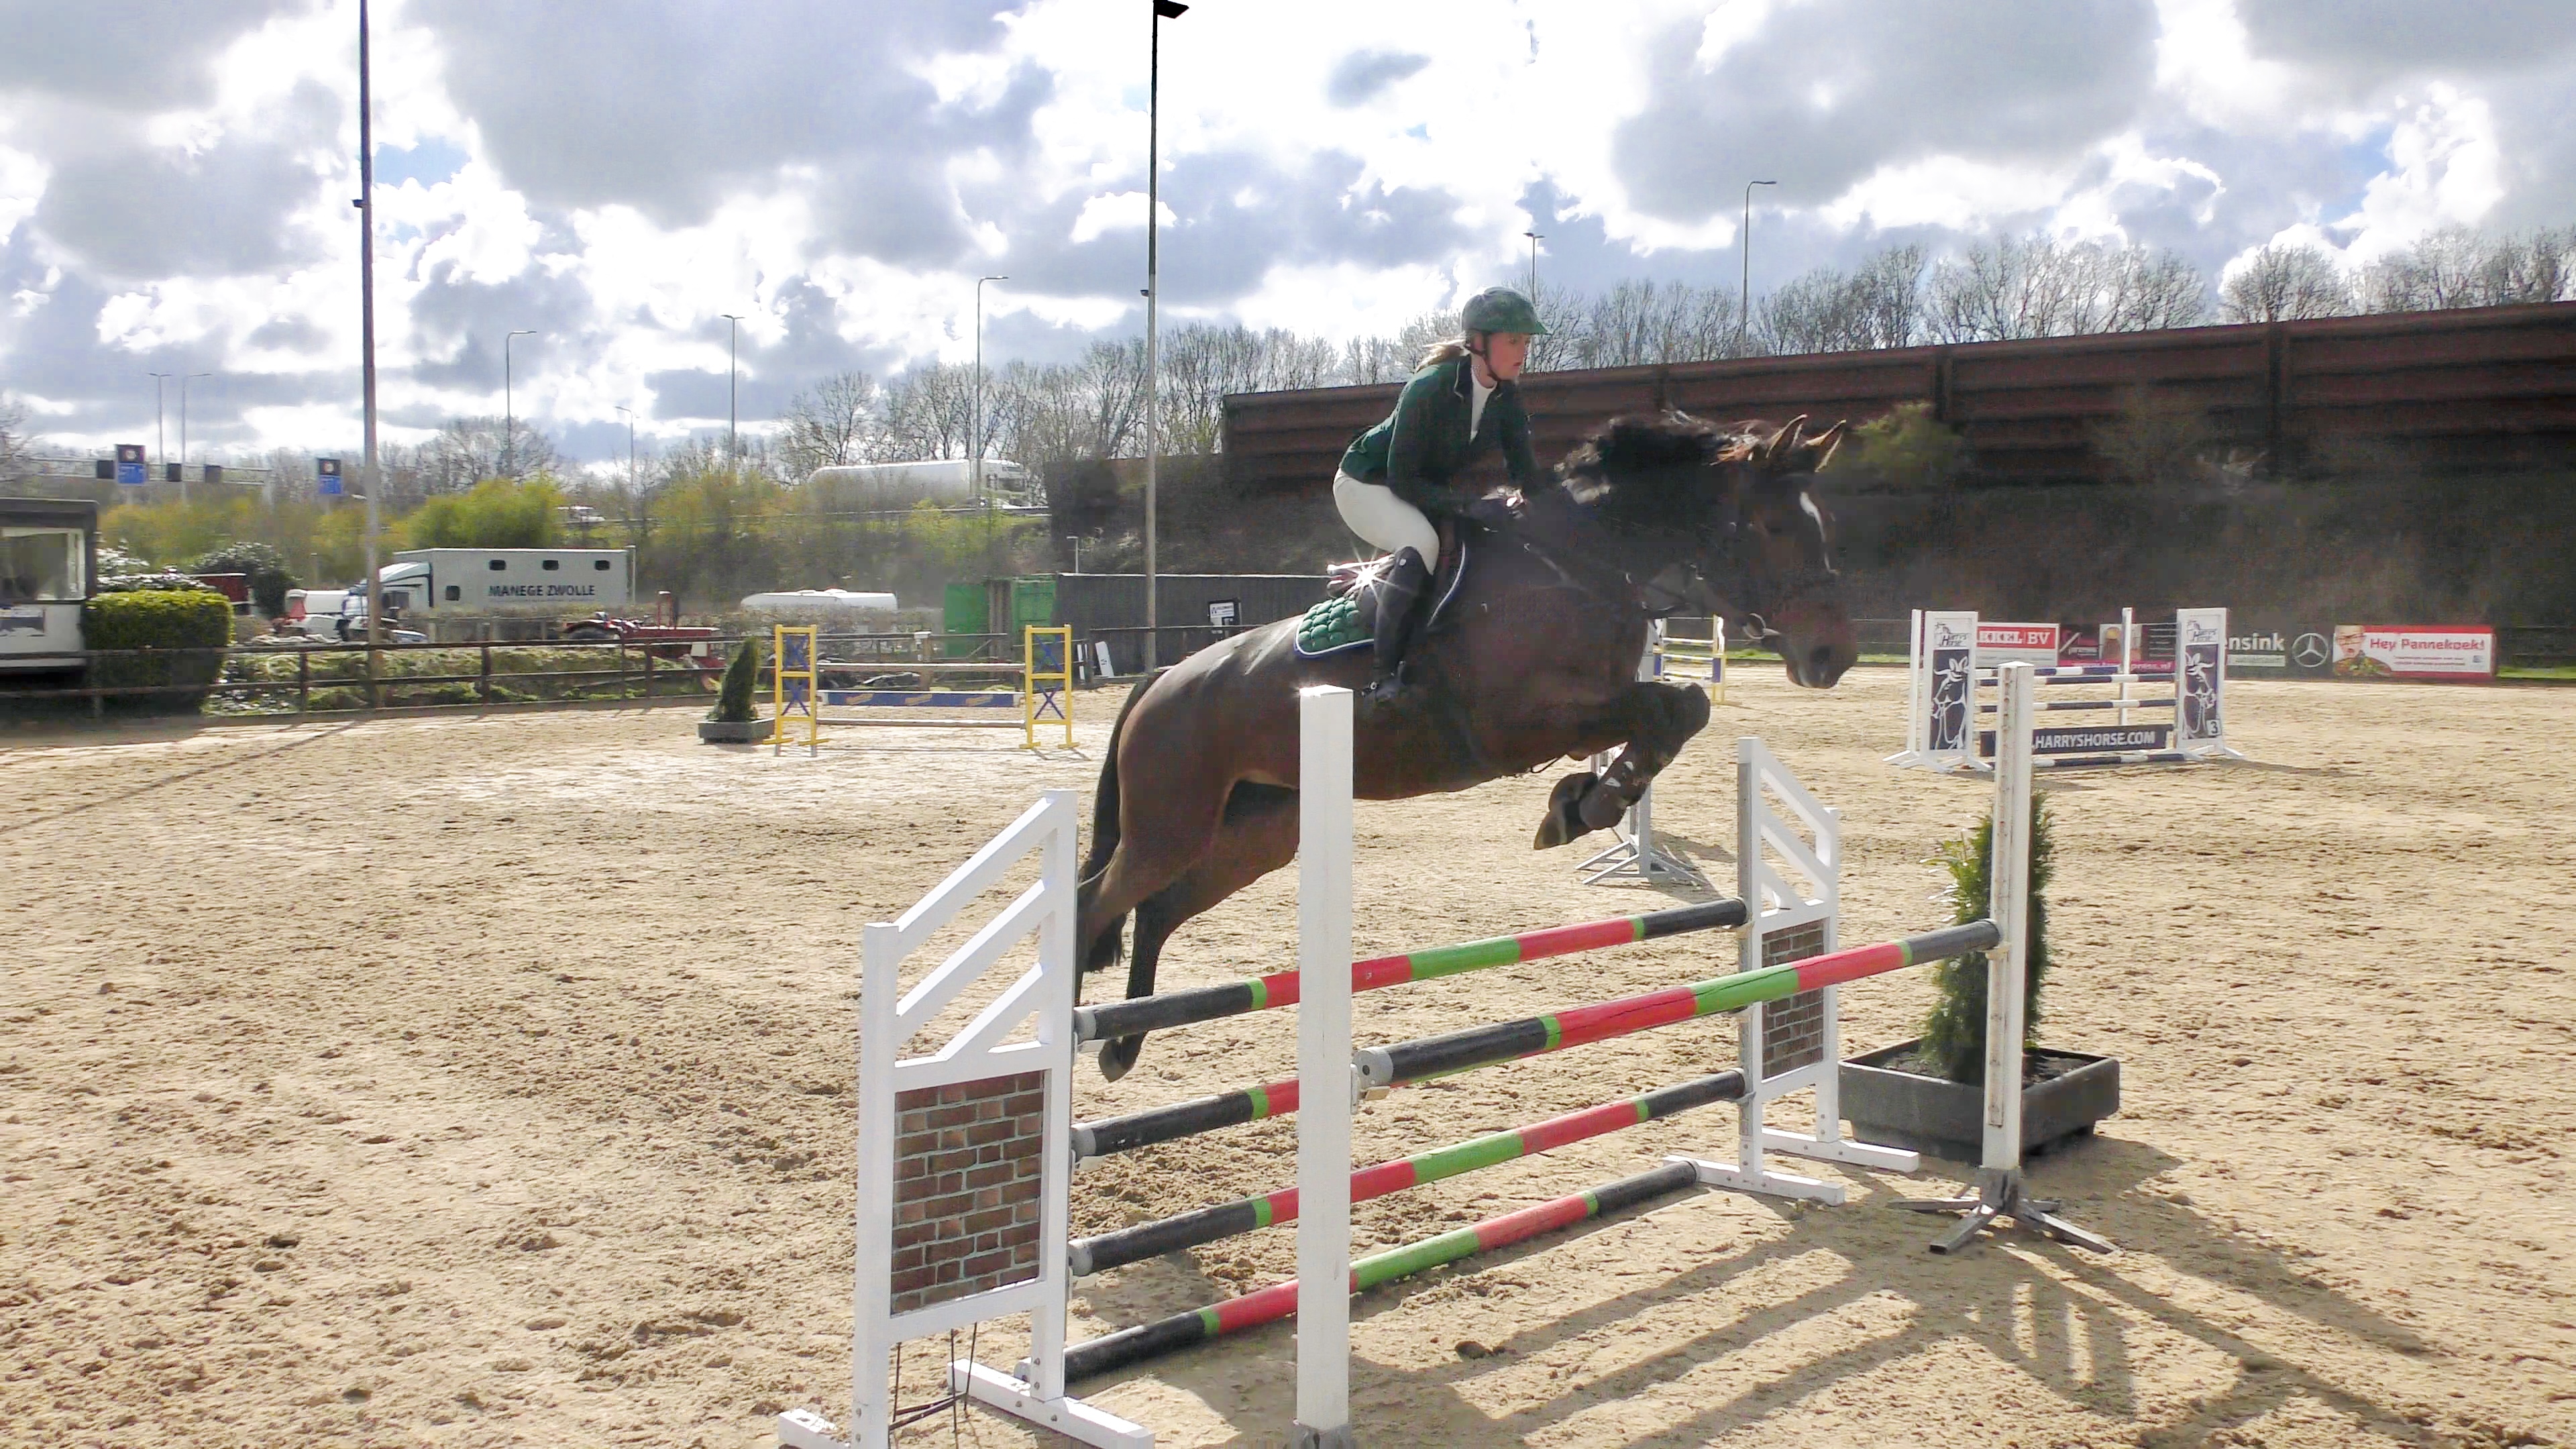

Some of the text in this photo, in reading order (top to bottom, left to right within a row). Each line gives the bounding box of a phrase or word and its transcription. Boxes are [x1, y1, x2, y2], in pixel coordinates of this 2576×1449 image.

[488, 584, 596, 596] MANEGE ZWOLLE
[2027, 631, 2051, 645] BV
[2225, 632, 2285, 651] nsink
[2369, 638, 2485, 651] Hey Pannekoek!
[2210, 720, 2218, 734] 3
